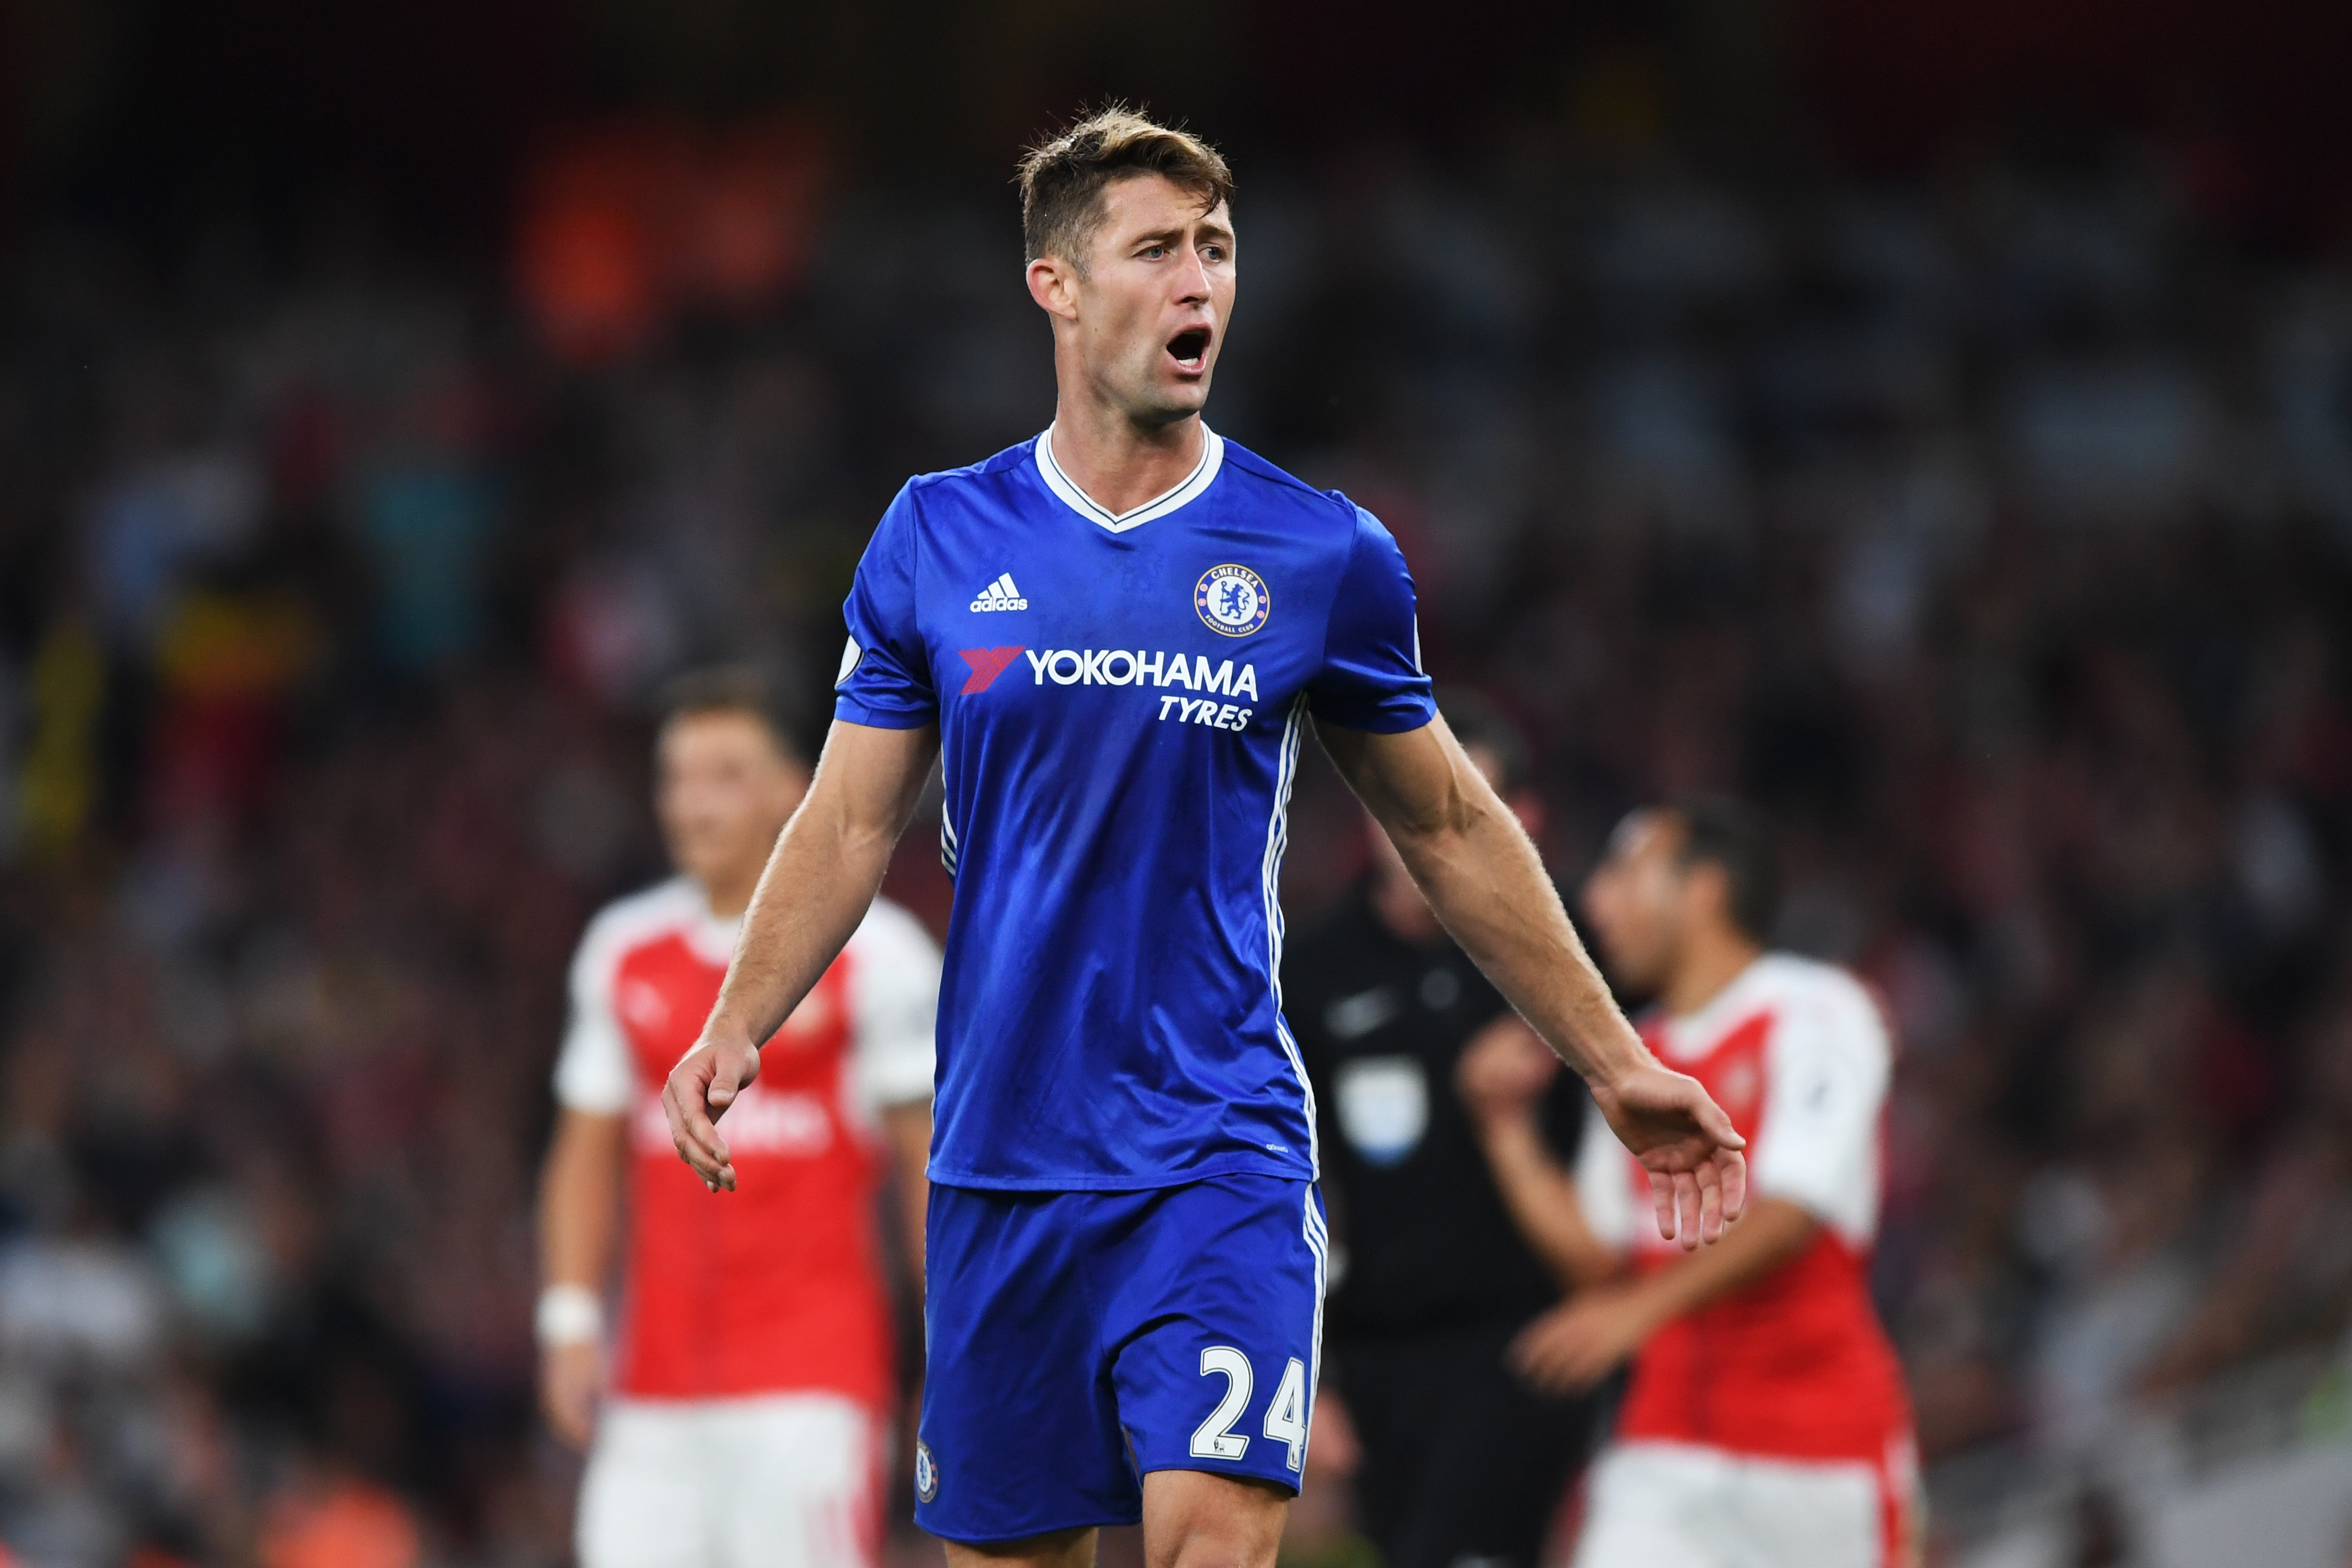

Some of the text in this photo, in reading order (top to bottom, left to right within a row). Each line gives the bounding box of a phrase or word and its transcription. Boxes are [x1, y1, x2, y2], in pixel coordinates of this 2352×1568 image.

[1211, 567, 1259, 588] CHELSEA
[970, 597, 1028, 612] adidas
[1205, 614, 1254, 633] FOOTBALL CLUB
[1025, 649, 1258, 701] YOKOHAMA
[1158, 695, 1253, 731] TYRES
[1190, 1346, 1306, 1472] 24
